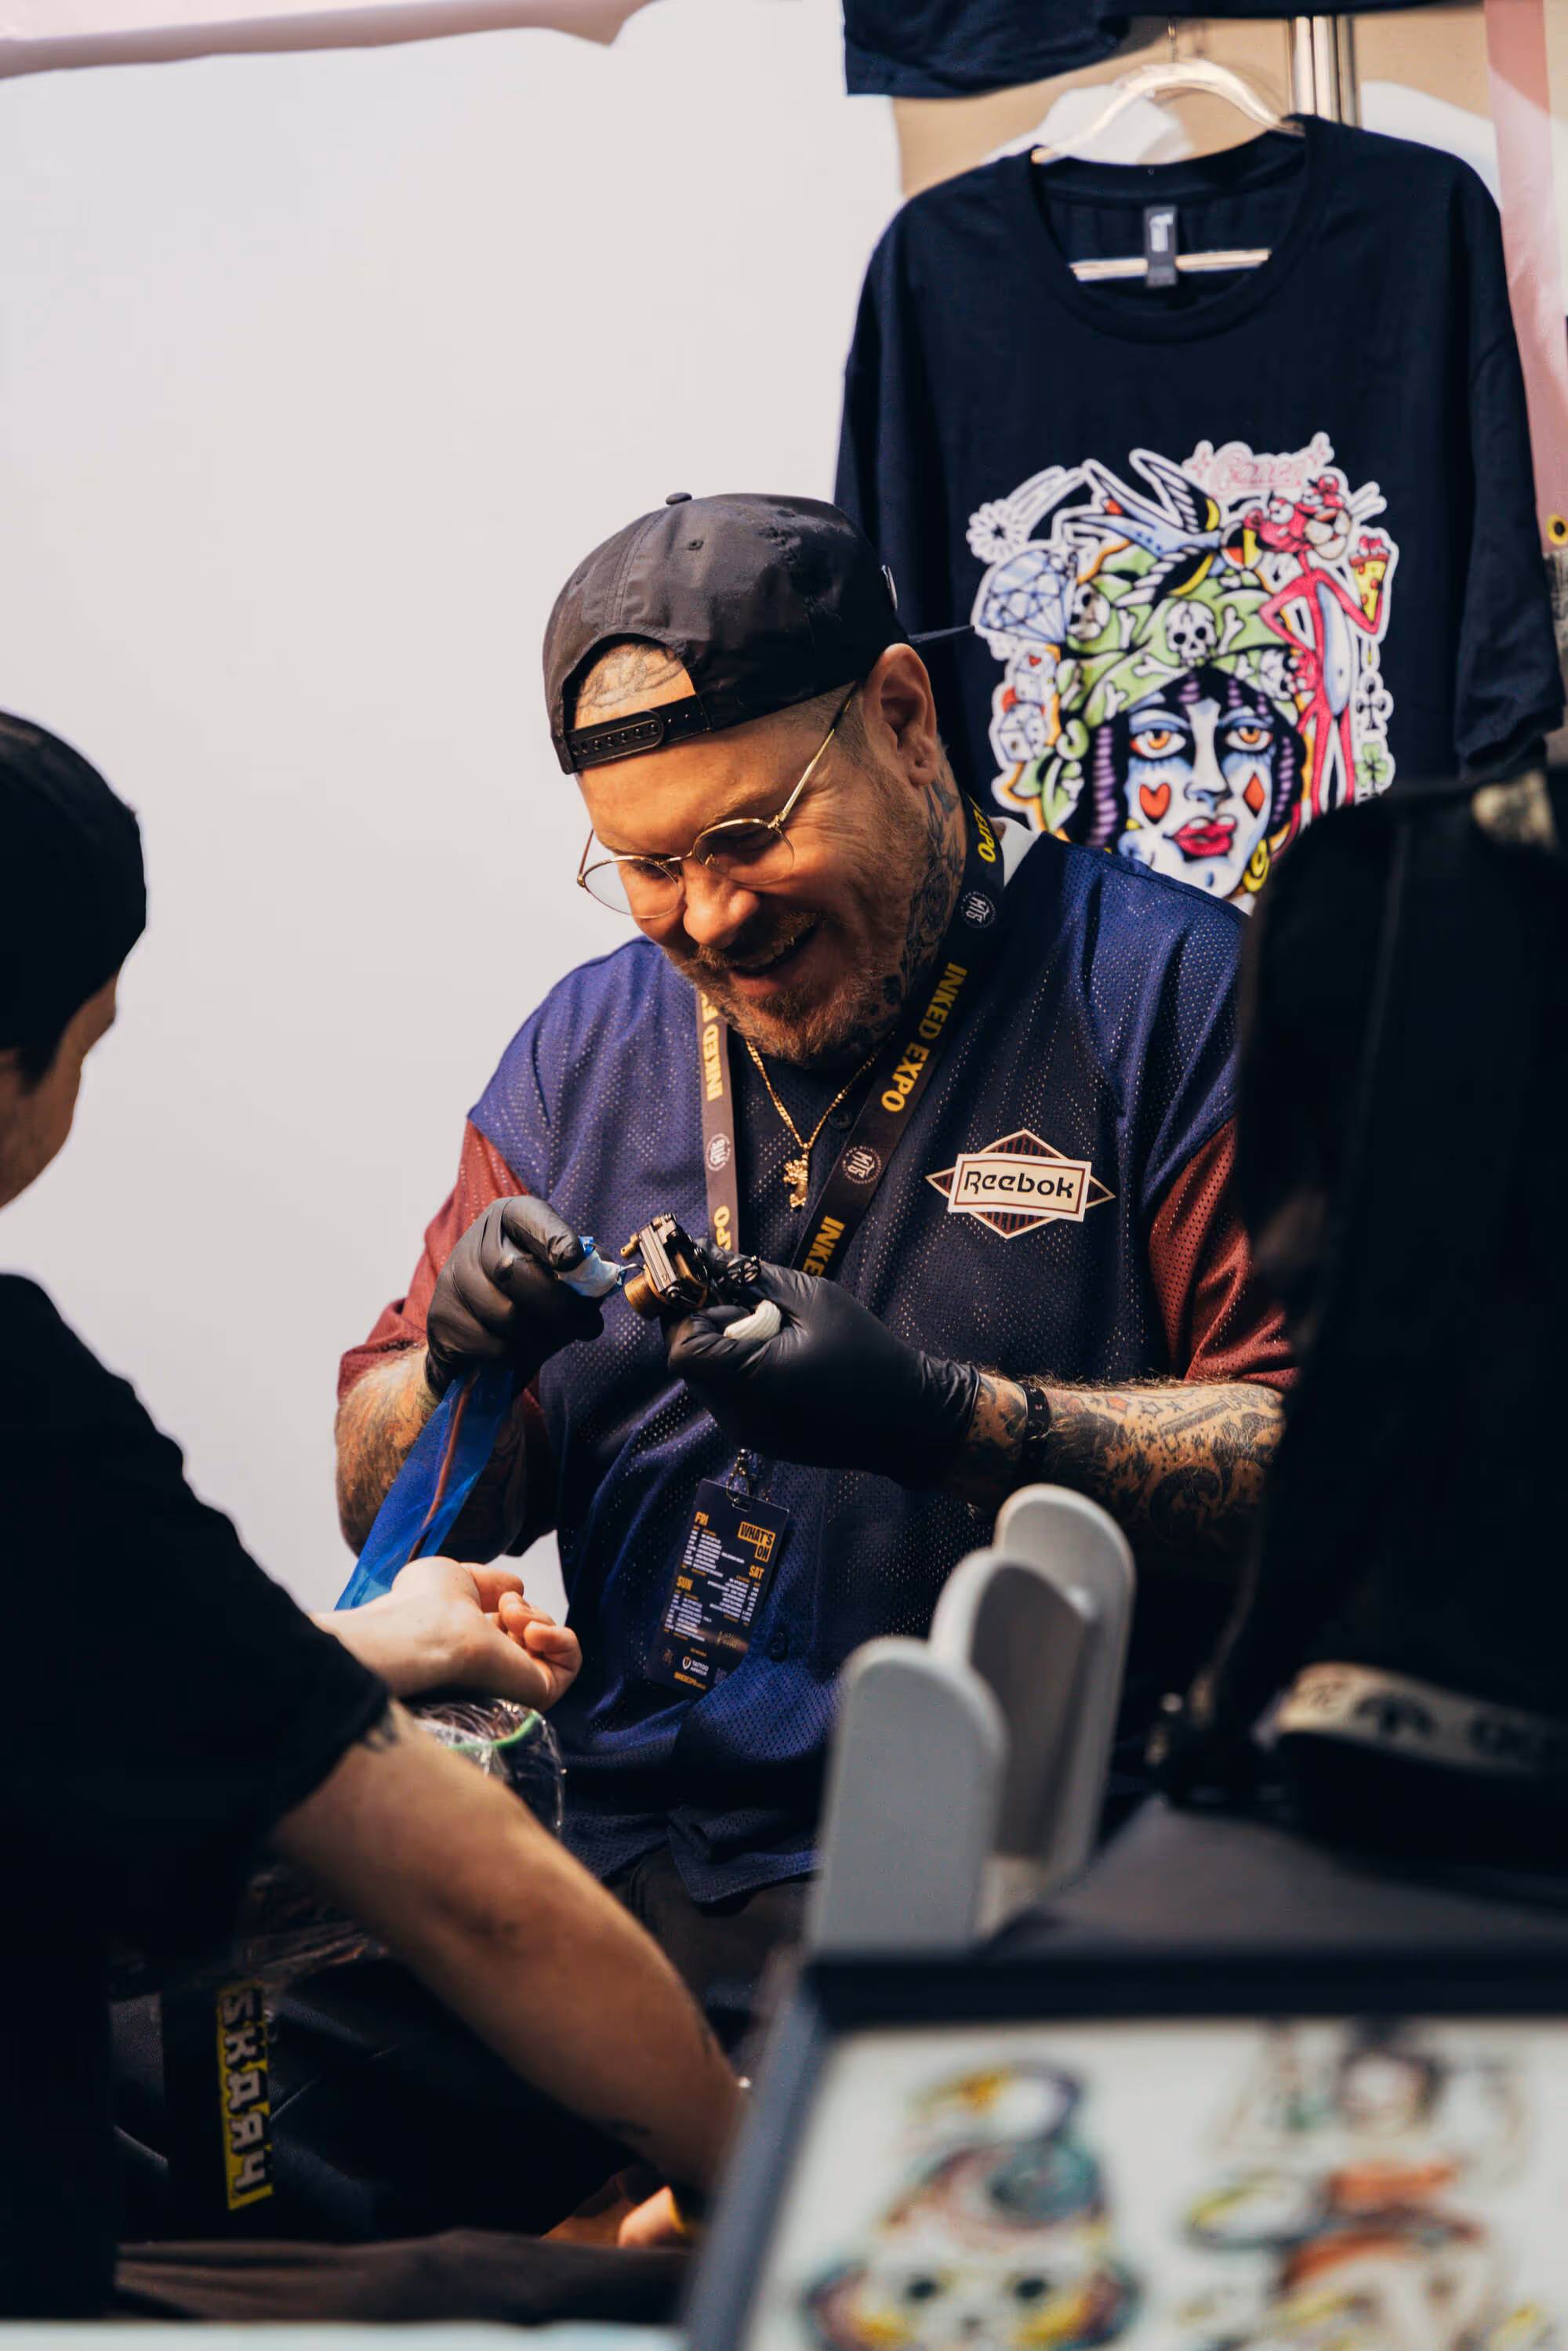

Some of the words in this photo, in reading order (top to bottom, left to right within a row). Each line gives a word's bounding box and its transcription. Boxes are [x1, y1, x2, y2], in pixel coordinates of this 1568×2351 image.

[919, 962, 968, 1040] INKED
[702, 1023, 723, 1101] INKED
[881, 1043, 931, 1113] EXPO
[963, 1170, 1075, 1200] Reebok
[802, 1216, 846, 1277] INKE
[695, 1511, 709, 1526] FRI
[740, 1523, 773, 1546] WHAT'S
[757, 1545, 771, 1558] ON
[676, 1575, 693, 1591] SUN
[749, 1565, 764, 1580] SAT
